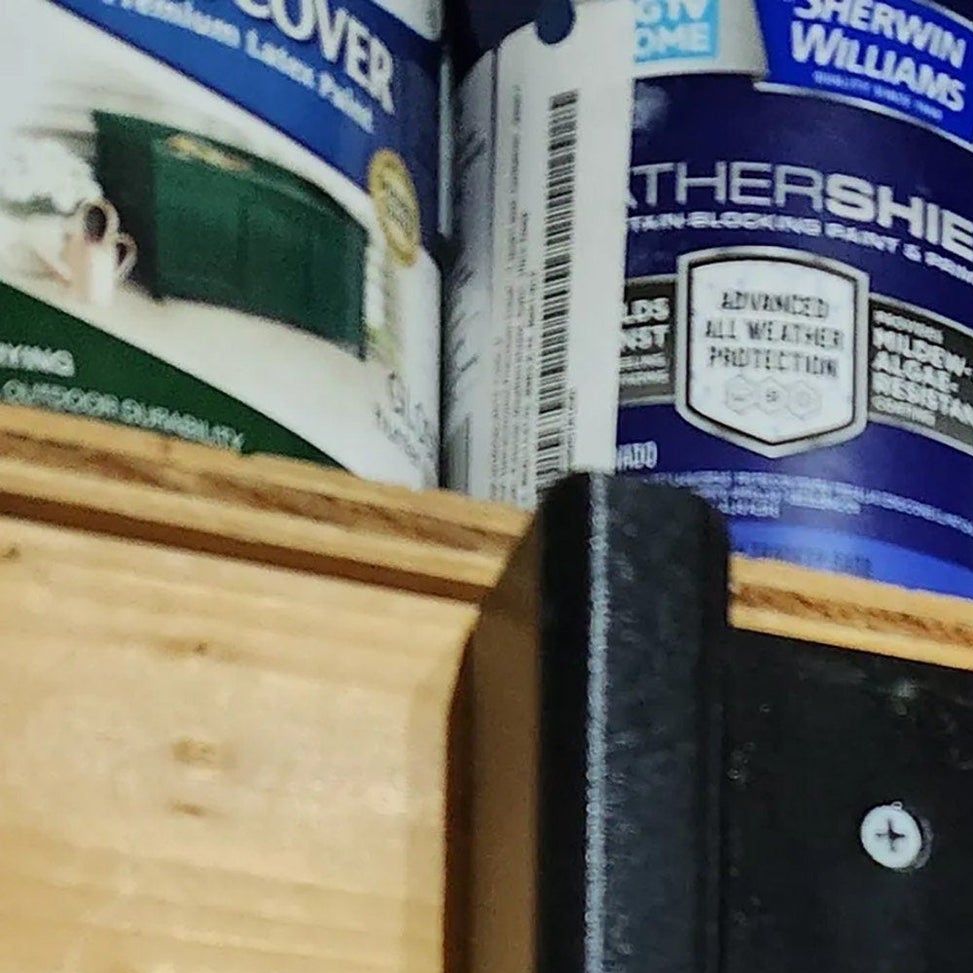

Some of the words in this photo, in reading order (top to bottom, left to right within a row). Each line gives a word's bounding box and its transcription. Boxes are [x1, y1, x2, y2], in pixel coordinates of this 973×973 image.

[794, 0, 967, 69] SHERWIN
[790, 20, 966, 112] WILLIAMS
[825, 222, 899, 254] PAINT
[901, 242, 922, 263] &
[721, 290, 831, 319] ADVANCED
[706, 320, 737, 339] ALL
[746, 320, 845, 350] WEATHER
[709, 345, 840, 377] PROTECTION
[120, 398, 245, 450] DURABILITY
